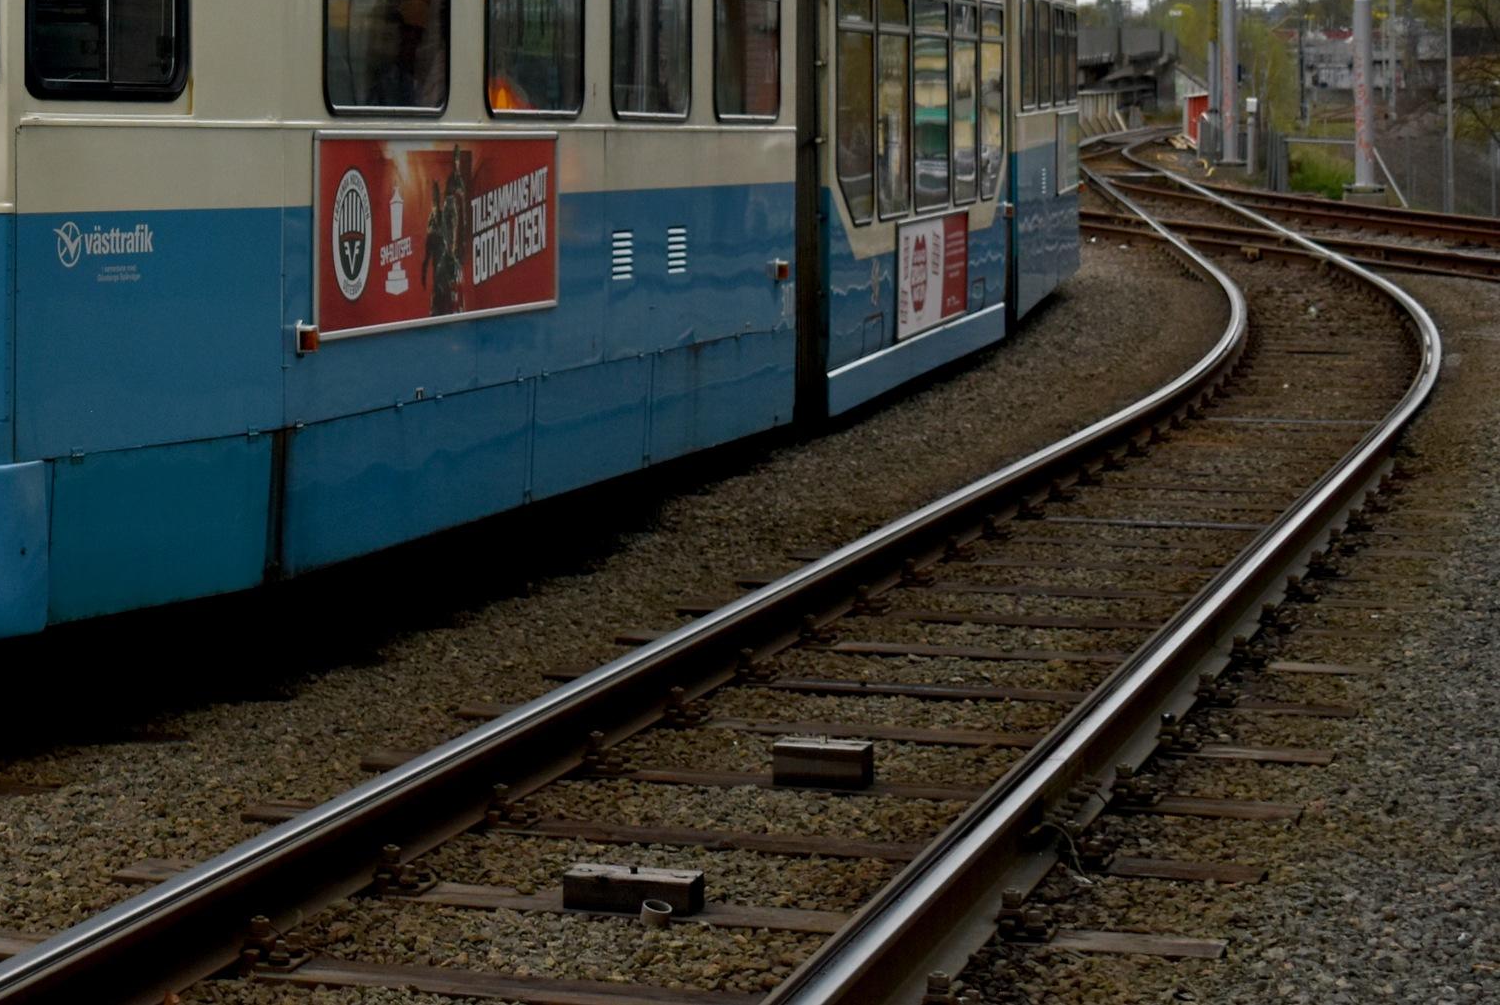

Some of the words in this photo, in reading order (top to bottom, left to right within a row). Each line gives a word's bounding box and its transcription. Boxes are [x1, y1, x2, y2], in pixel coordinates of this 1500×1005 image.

[471, 175, 529, 234] TILLSAMMANS
[530, 164, 548, 207] MOT
[84, 224, 154, 255] västtrafik
